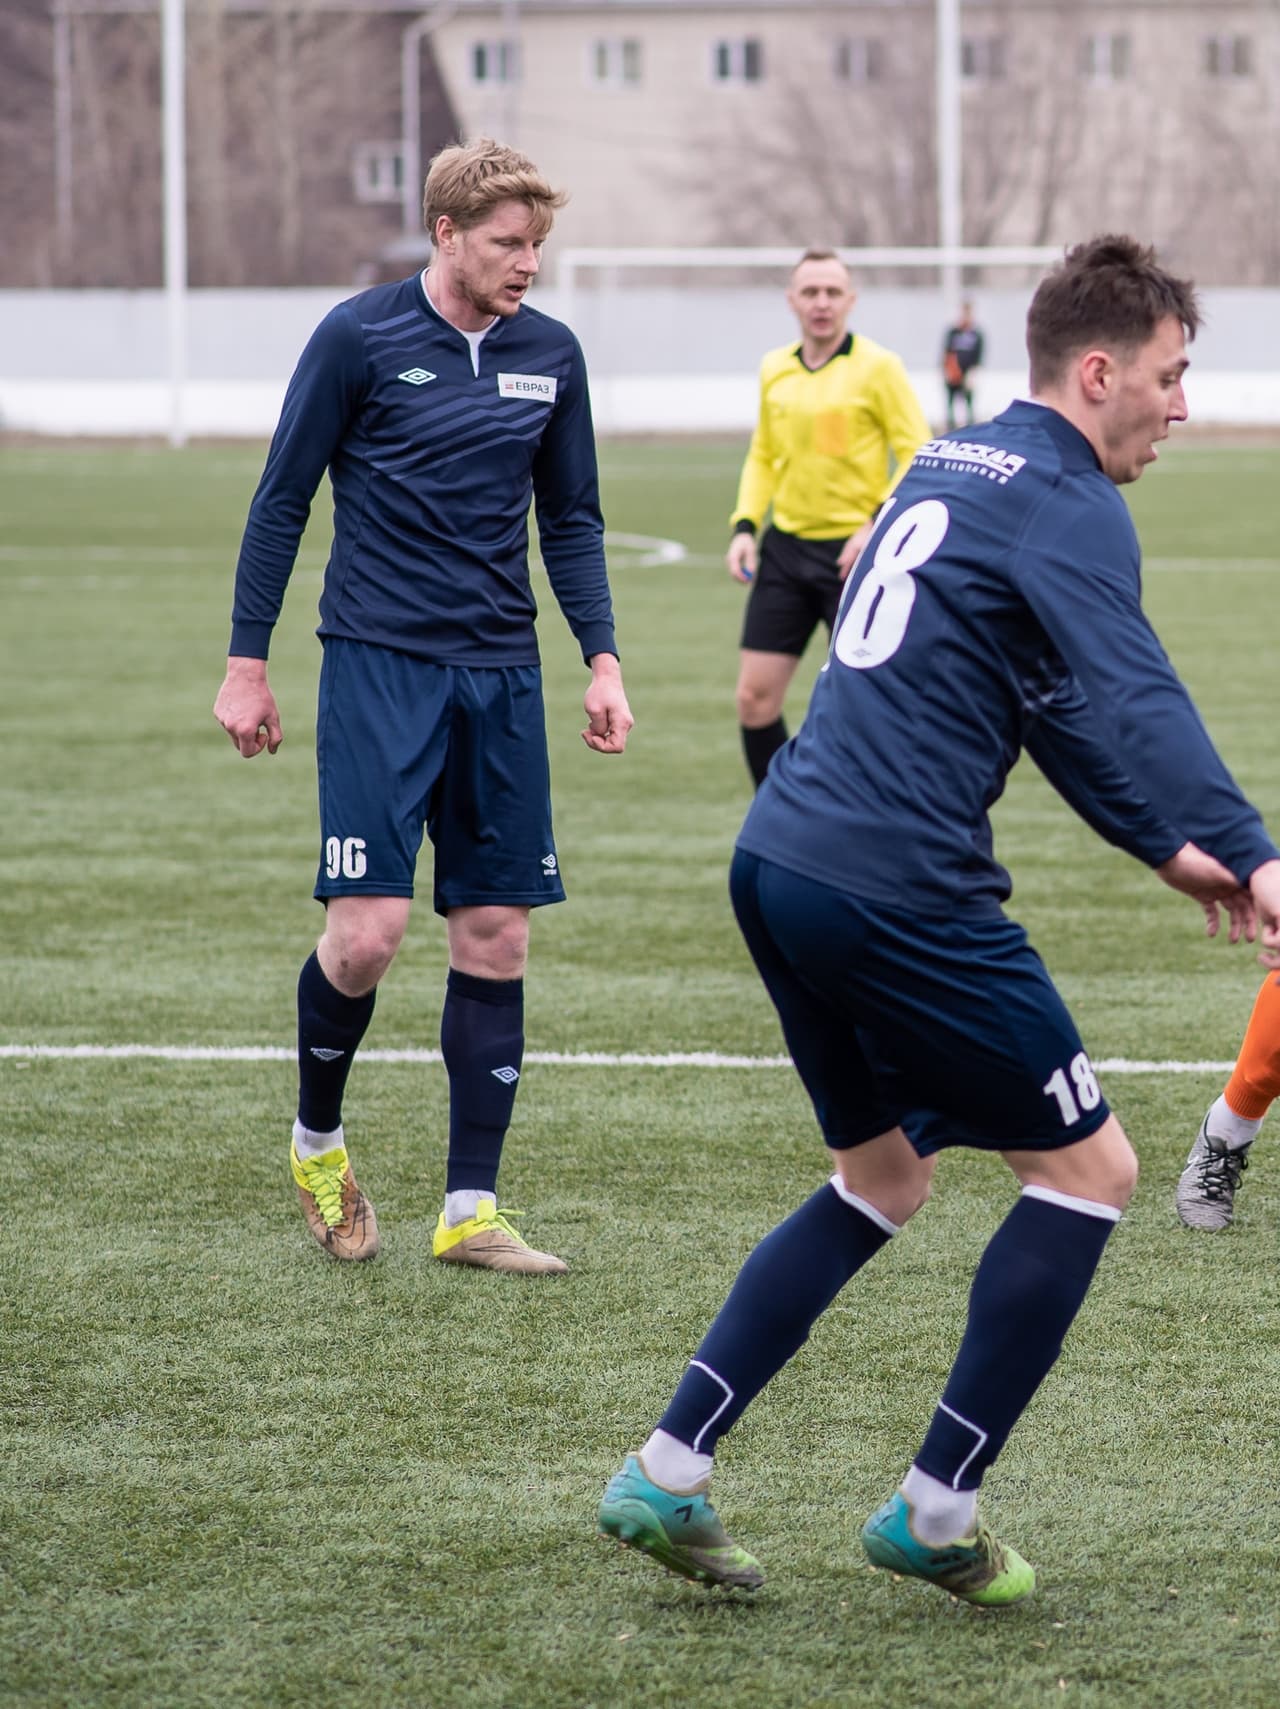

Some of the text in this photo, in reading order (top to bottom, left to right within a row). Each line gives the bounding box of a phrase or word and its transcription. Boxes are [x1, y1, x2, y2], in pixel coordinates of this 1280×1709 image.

[515, 381, 550, 394] ЕВРАЗ
[326, 836, 367, 879] 96
[1043, 1052, 1100, 1126] 18
